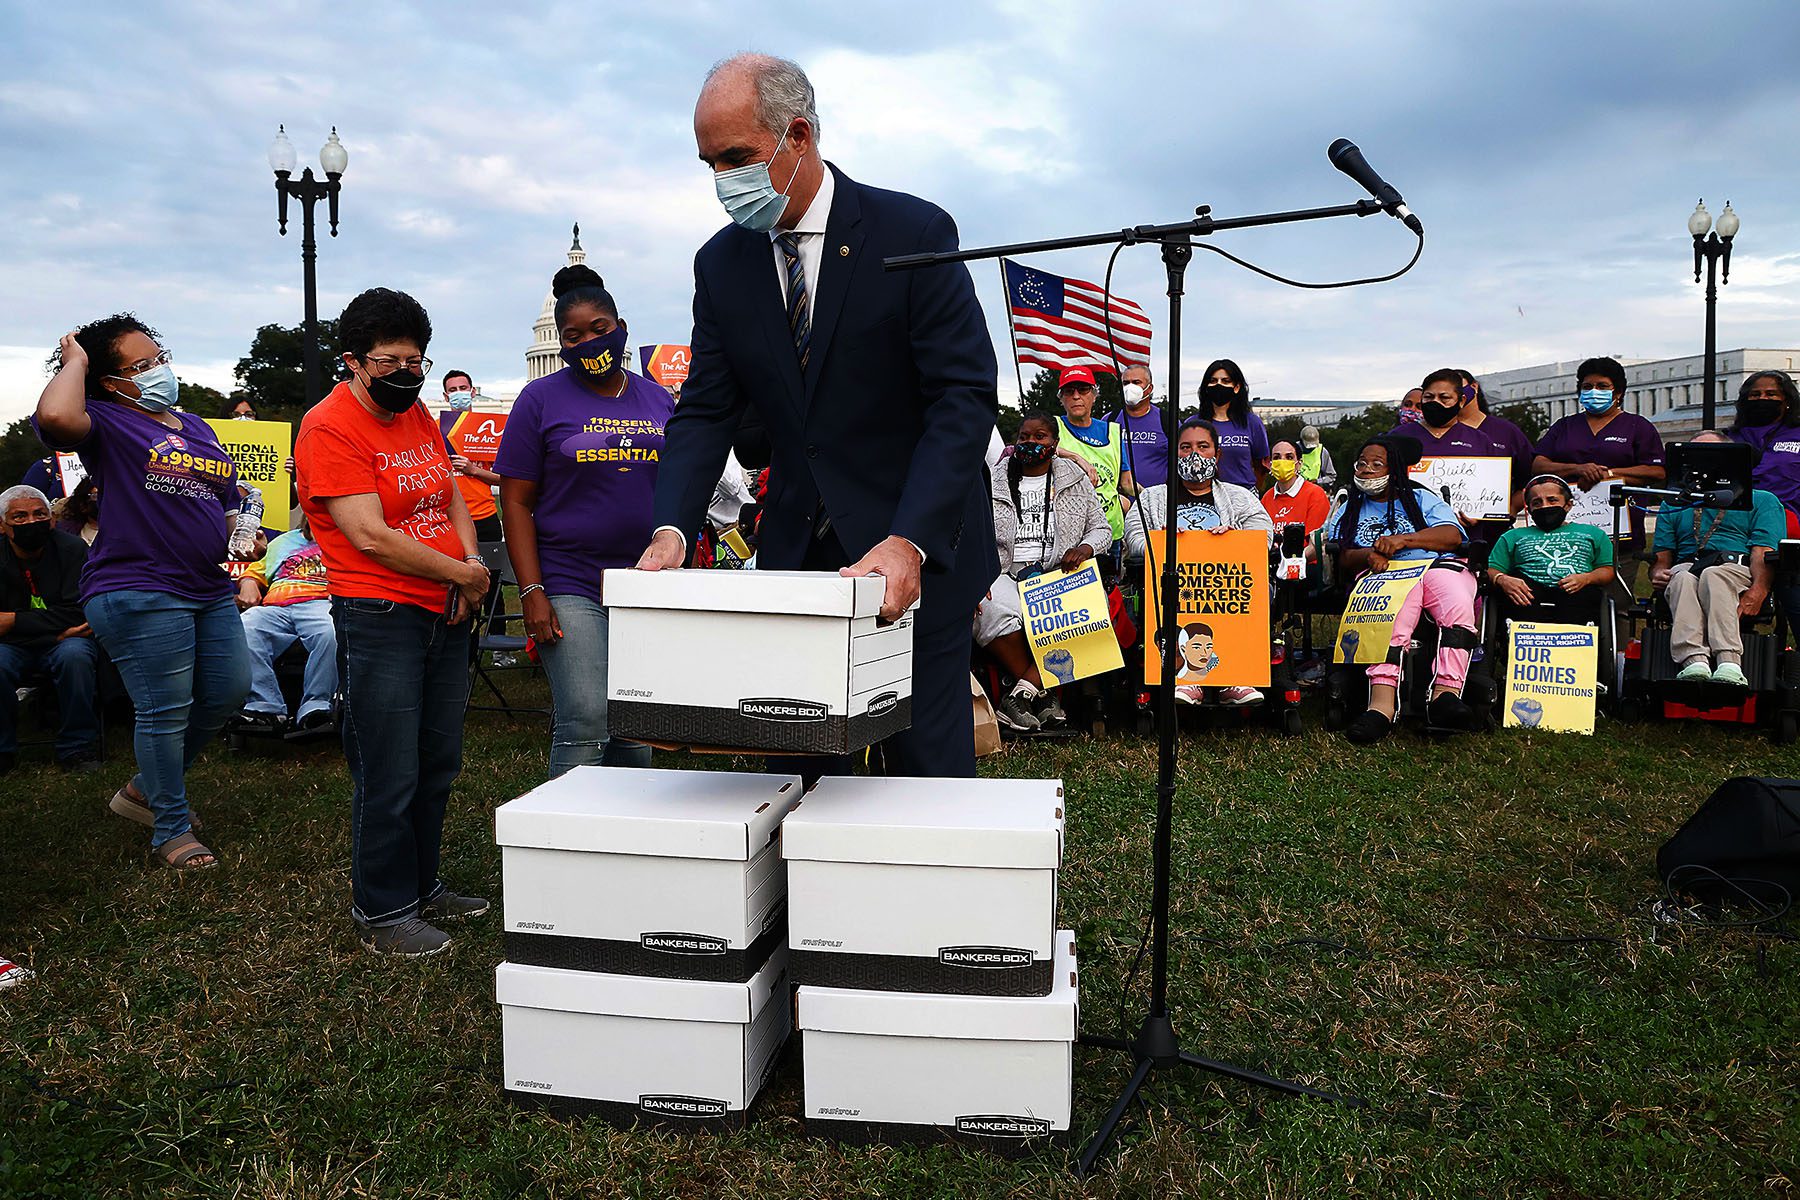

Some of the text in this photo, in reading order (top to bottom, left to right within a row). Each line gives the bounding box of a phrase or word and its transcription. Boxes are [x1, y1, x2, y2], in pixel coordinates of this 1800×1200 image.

[580, 349, 613, 370] VOTE
[590, 417, 652, 427] 1199SEIU
[583, 424, 665, 436] HOMECARE
[1134, 431, 1157, 441] 2015
[464, 434, 496, 443] The Arc
[619, 435, 633, 447] is
[1224, 435, 1249, 444] 2015
[222, 443, 278, 454] ATIONAL
[576, 448, 659, 462] ESSENTIA
[229, 453, 279, 463] MESTIC
[235, 462, 277, 472] RKERS
[1432, 458, 1477, 477] Build
[146, 473, 190, 487] QUALITY
[145, 482, 176, 494] GOOD
[1163, 563, 1251, 575] ATIONAL
[1027, 570, 1093, 598] DISABILITY RIGHTS
[1044, 588, 1063, 598] CIVIL
[1063, 577, 1090, 591] RIGHTS
[1161, 575, 1254, 588] OMESTIC
[1356, 580, 1385, 594] OUR
[1177, 588, 1251, 601] ORKERS
[1027, 597, 1063, 618] OUR
[1176, 602, 1250, 614] LLIANCE
[1348, 595, 1392, 612] HOMES
[1030, 608, 1090, 636] HOMES
[1345, 613, 1395, 624] NOT INSTITUTIONS
[1035, 620, 1110, 648] NOT INSTITUTIONS
[1515, 645, 1551, 663] OUR
[1514, 664, 1576, 685] HOMES
[1513, 683, 1593, 698] NOT INSTITUTIONS
[744, 704, 824, 717] BANKERS BOX
[646, 938, 723, 950] BANKERS BOX
[944, 952, 1029, 963] BANKERS BOX
[644, 1100, 723, 1113] BANKERS BOX
[961, 1121, 1046, 1133] BANKERS BOX
